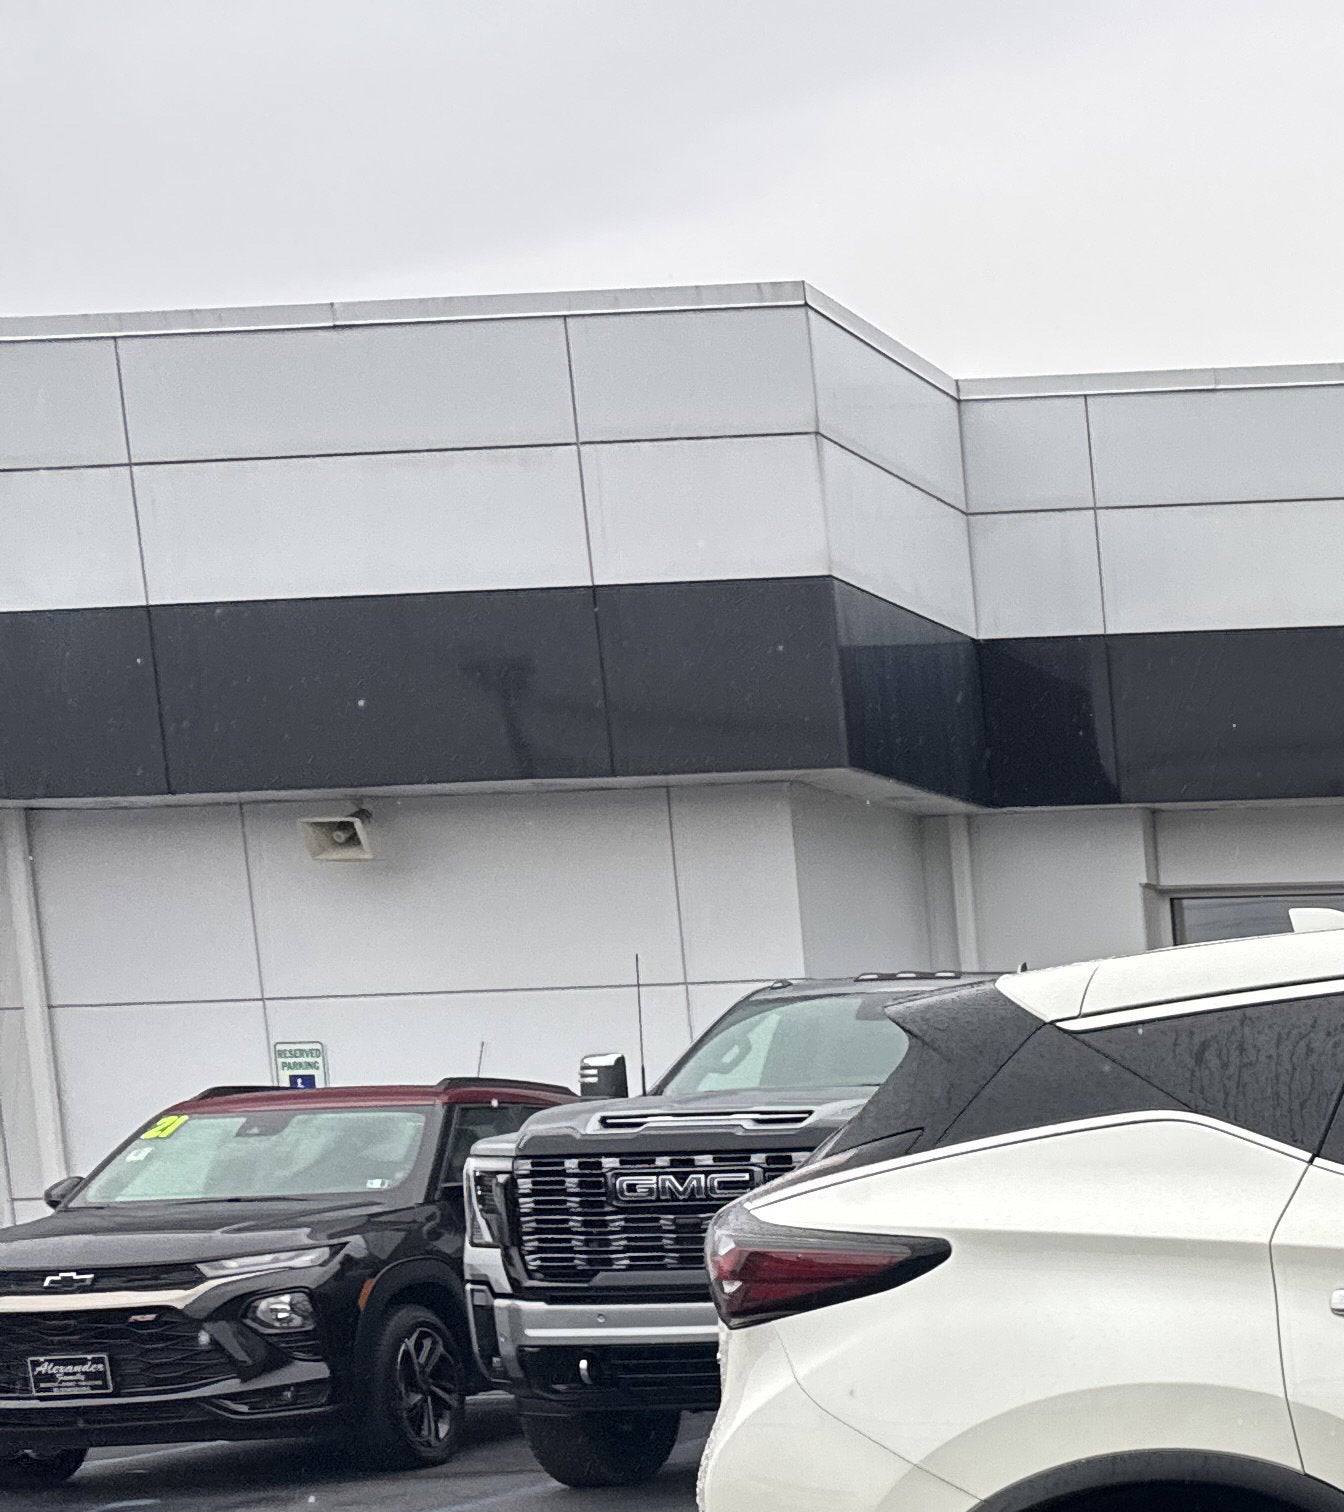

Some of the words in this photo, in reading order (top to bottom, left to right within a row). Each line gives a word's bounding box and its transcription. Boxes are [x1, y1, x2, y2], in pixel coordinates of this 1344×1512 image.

[277, 1048, 321, 1059] RESERVED
[281, 1060, 320, 1071] PARKING
[616, 1172, 751, 1200] GMC
[33, 1361, 105, 1375] Alexander
